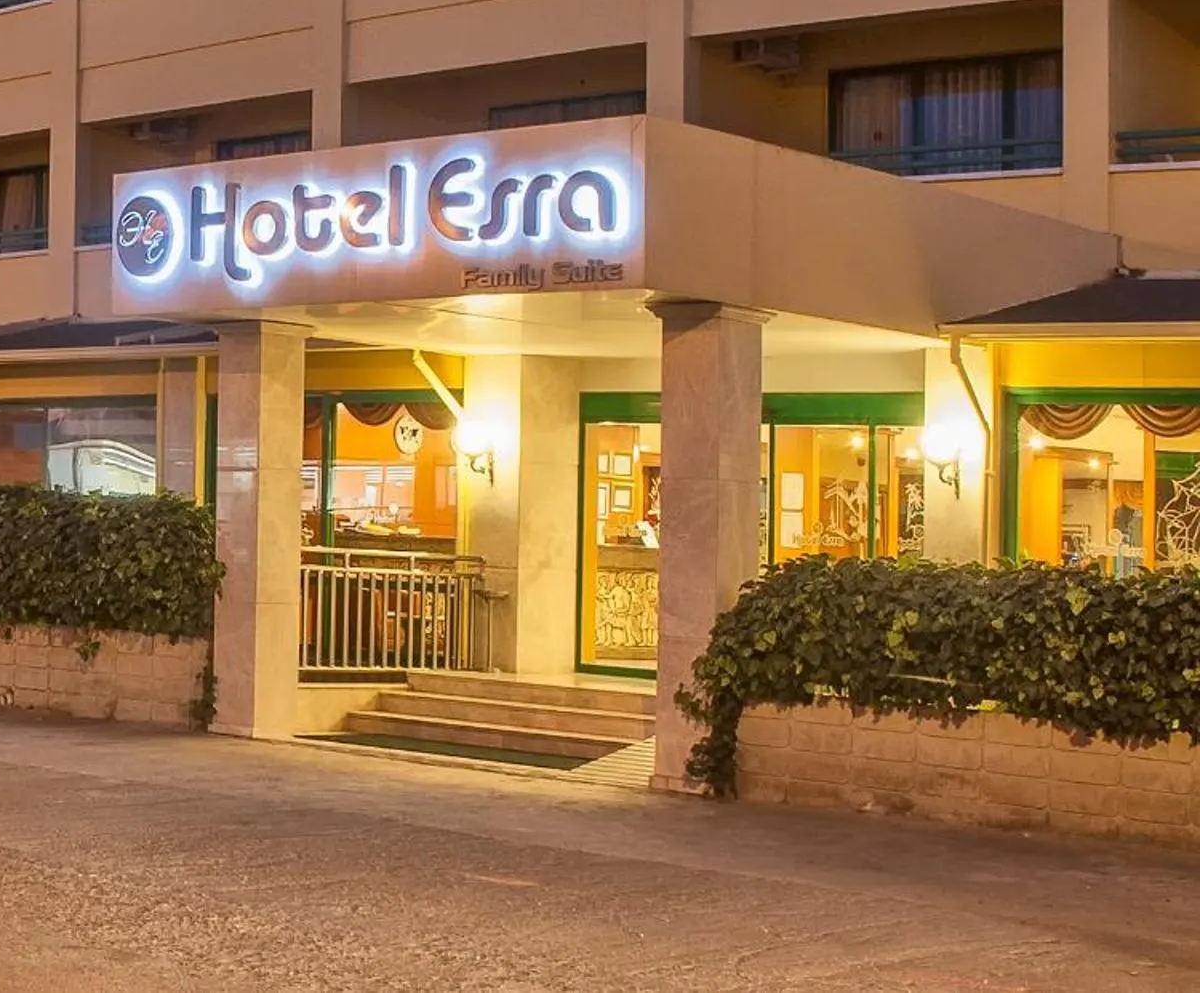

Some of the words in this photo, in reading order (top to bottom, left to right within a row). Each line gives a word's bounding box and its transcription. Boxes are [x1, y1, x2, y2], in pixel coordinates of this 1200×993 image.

[189, 165, 407, 281] Hotel
[428, 157, 617, 242] Esra
[461, 263, 546, 291] Family
[552, 258, 625, 285] Suite
